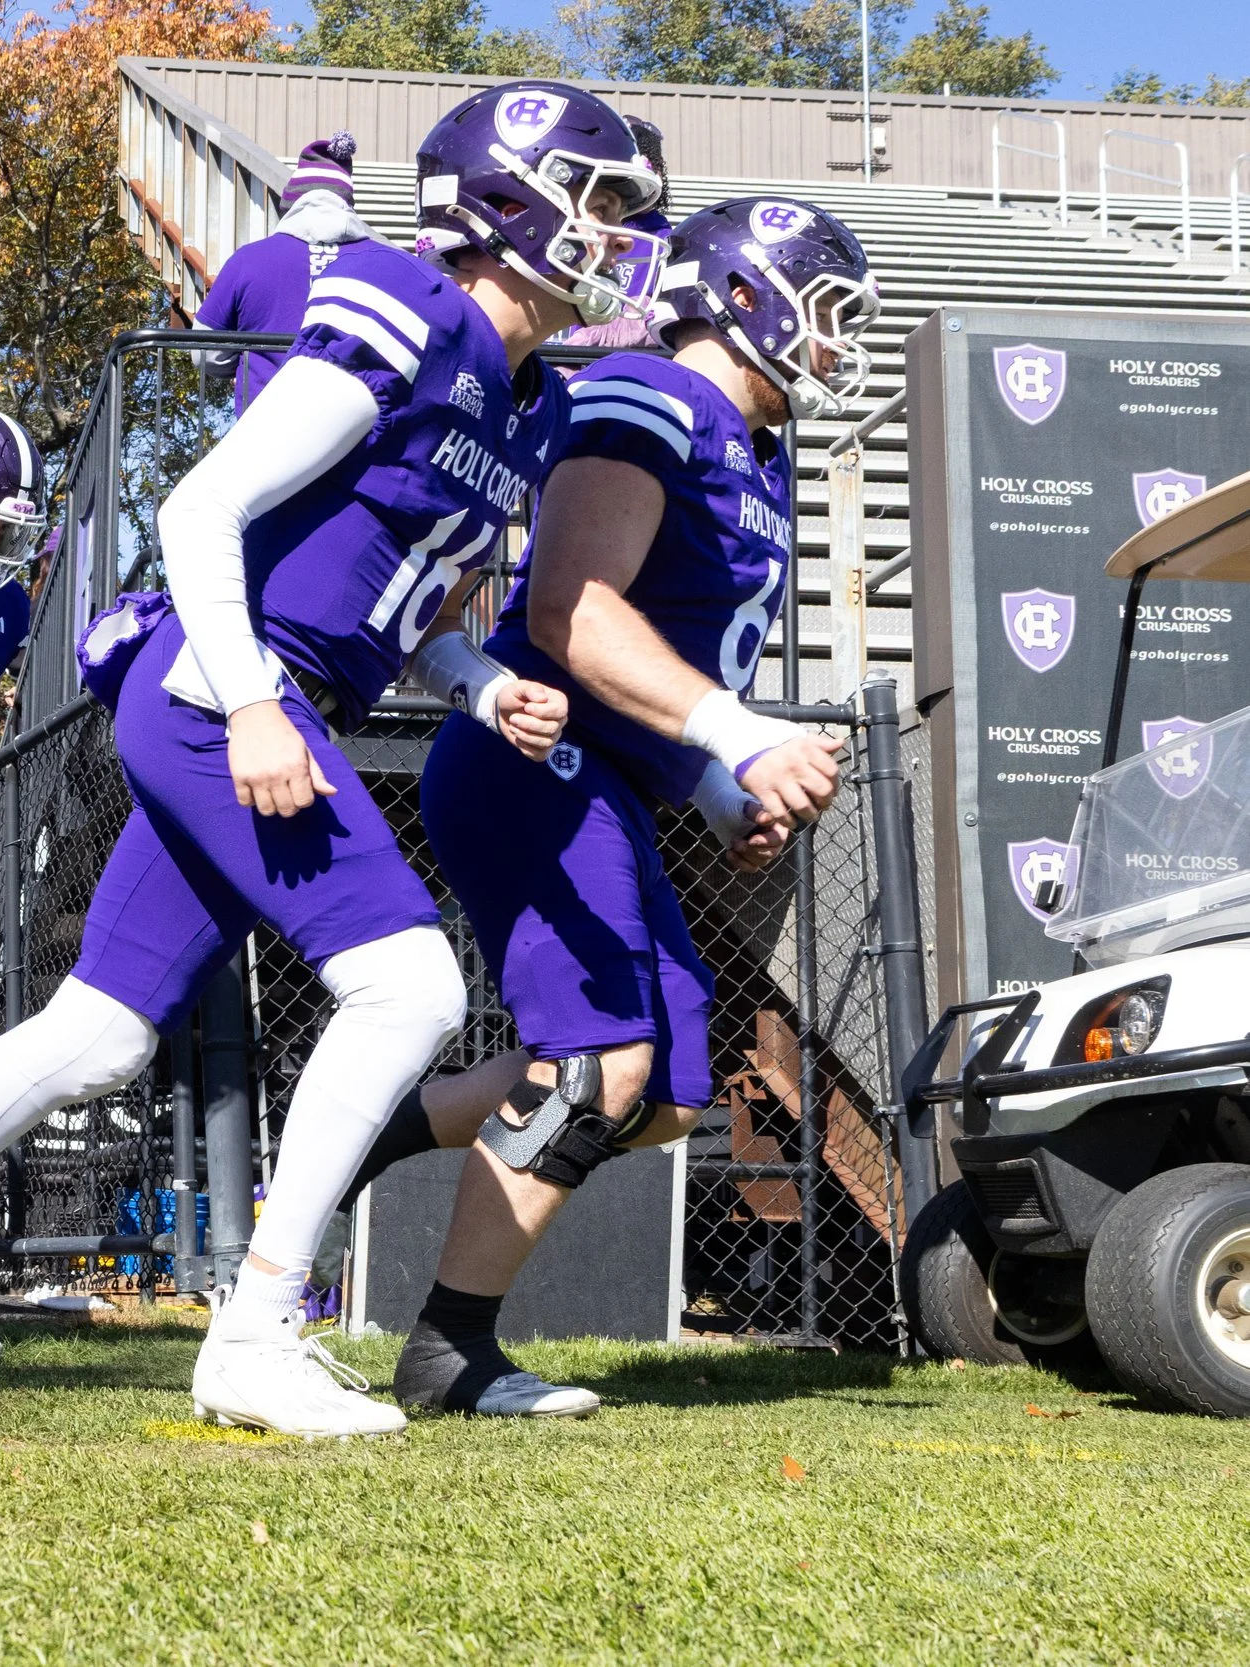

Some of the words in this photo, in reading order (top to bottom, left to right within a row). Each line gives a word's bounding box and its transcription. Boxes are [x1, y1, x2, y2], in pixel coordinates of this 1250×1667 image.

[1109, 359, 1156, 375] HOLY
[1161, 361, 1222, 377] CROSS
[1128, 376, 1201, 387] CRUSADERS
[1119, 403, 1219, 415] @goholycross
[430, 428, 494, 492] HOLY
[486, 462, 529, 516] CROS
[980, 477, 1028, 492] HOLY
[1032, 479, 1093, 495] CROSS
[1000, 493, 1072, 506] CRUSADERS
[738, 491, 771, 540] HOLY
[989, 521, 1090, 534] @goholycross
[368, 508, 496, 654] 16
[1171, 606, 1232, 623] CROSS
[1138, 621, 1211, 633] CRUSADERS
[1130, 650, 1229, 662] @goholycross
[988, 726, 1035, 742] HOLY
[1040, 728, 1102, 745] CROSS
[1007, 743, 1081, 755] CRUSADERS
[1126, 853, 1172, 868] HOLY
[1178, 855, 1239, 871] CROSS
[1145, 871, 1217, 882] CRUSADERS
